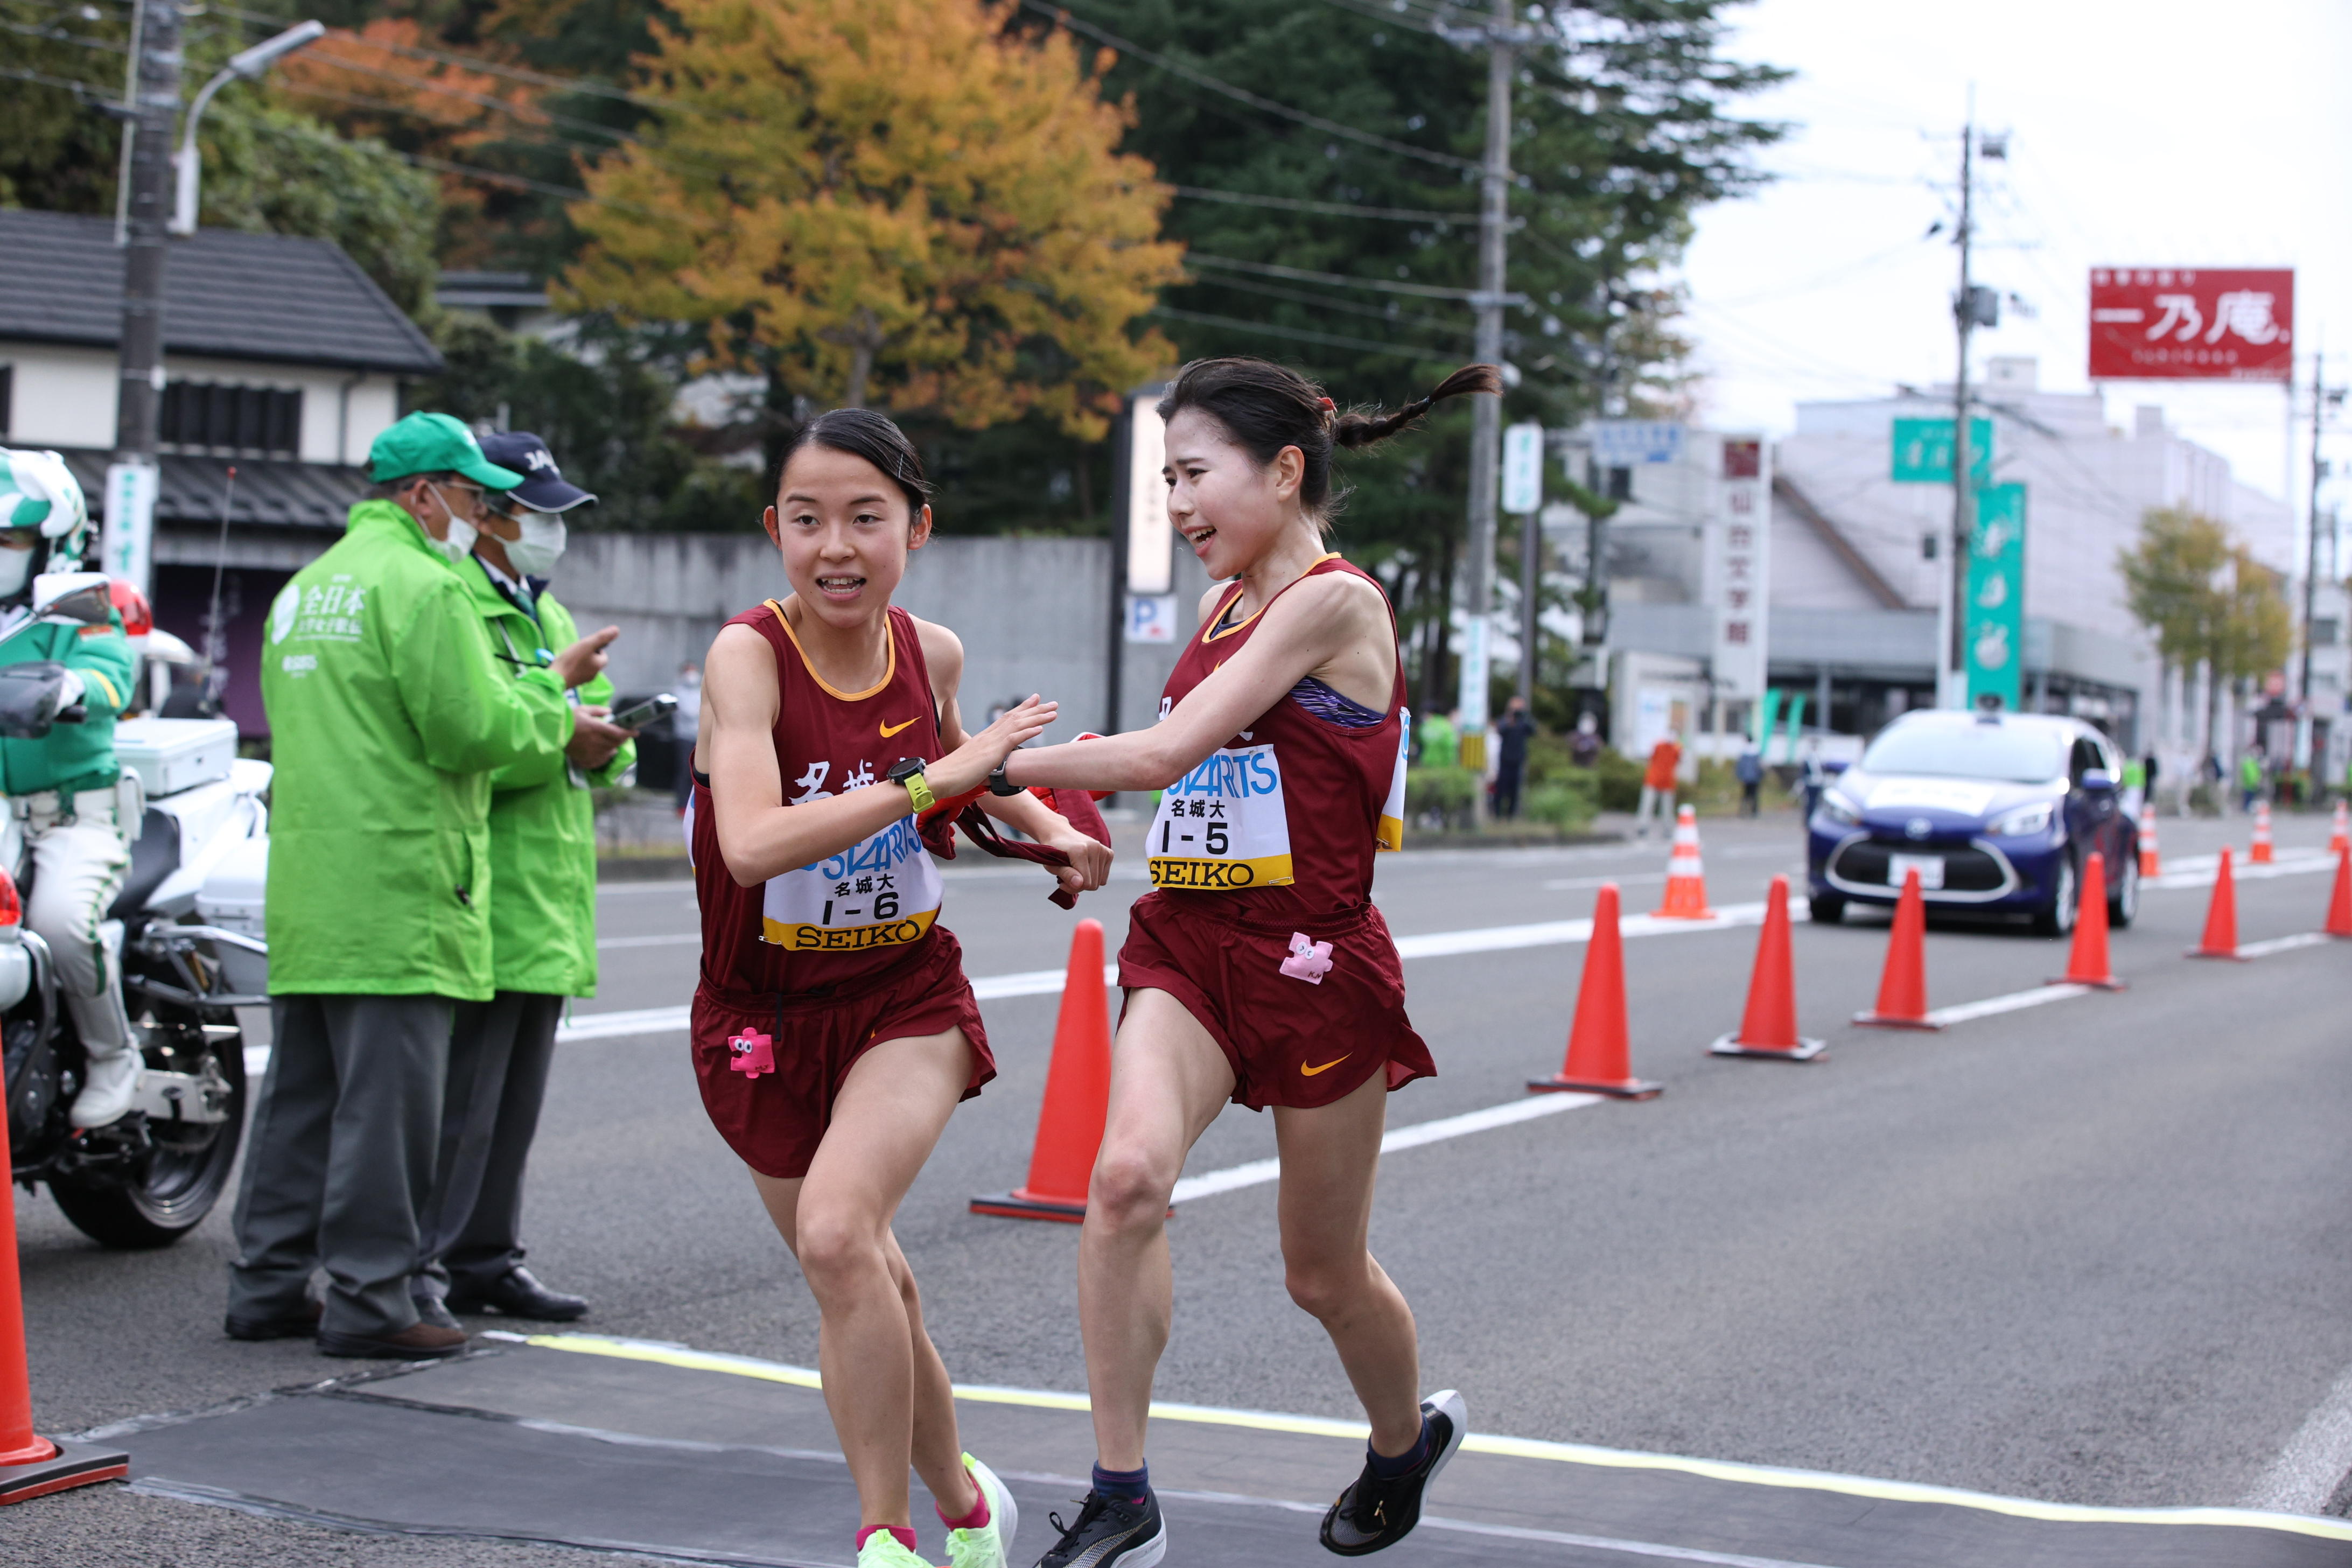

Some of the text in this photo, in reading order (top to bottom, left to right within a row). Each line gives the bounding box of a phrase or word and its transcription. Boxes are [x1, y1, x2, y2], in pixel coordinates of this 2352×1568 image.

[299, 584, 366, 616] 全日本
[1134, 600, 1157, 632] P
[788, 757, 906, 806] 名城
[1171, 799, 1225, 818] 名城大
[1162, 820, 1228, 855] 1-5
[835, 873, 894, 897] 名城大
[1150, 860, 1254, 887] SEIKO
[822, 892, 899, 925] 1-6
[795, 920, 920, 949] SEIKO
